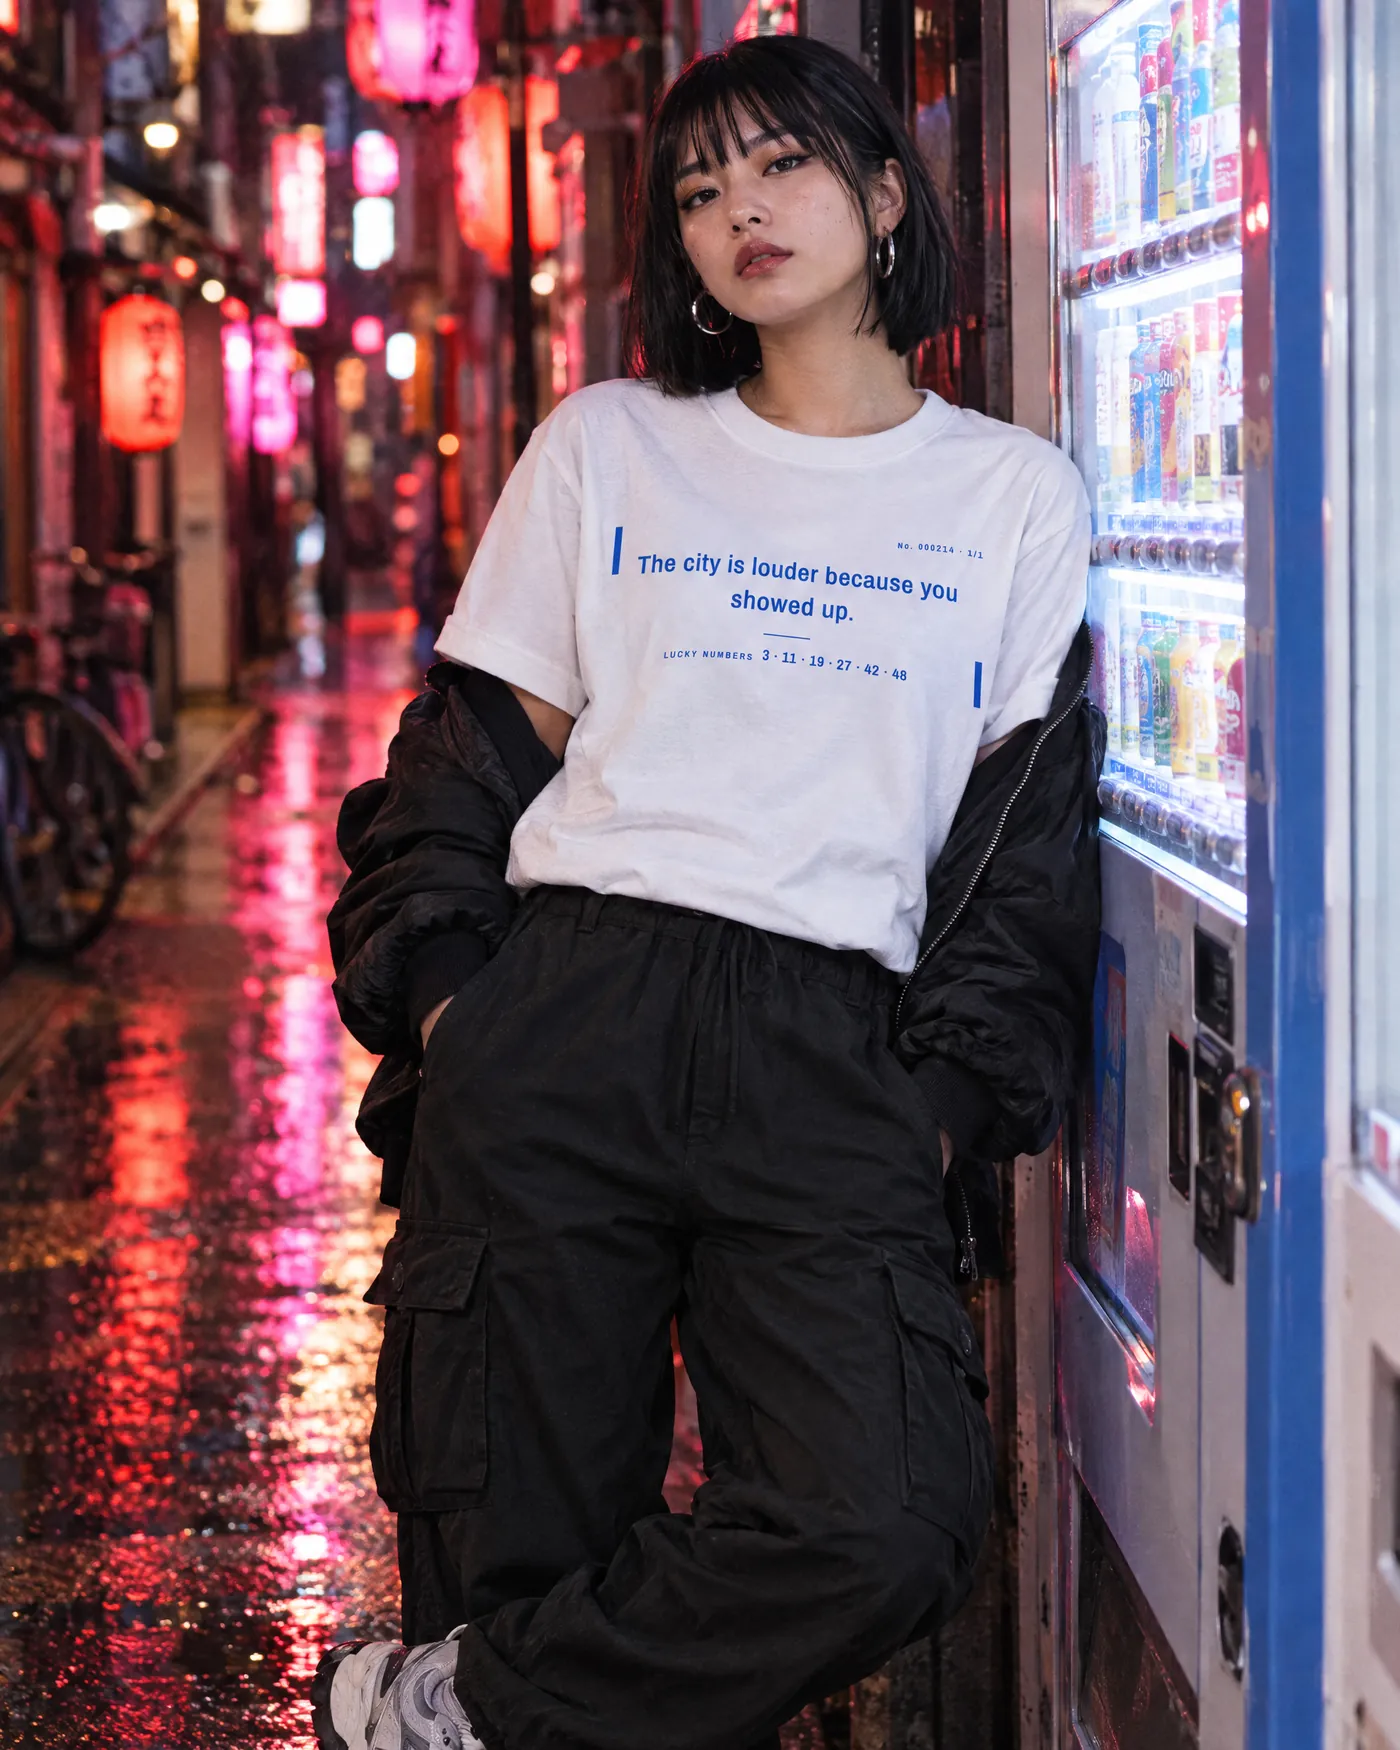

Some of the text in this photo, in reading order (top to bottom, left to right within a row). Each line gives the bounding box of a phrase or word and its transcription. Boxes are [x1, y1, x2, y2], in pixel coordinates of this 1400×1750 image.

[896, 541, 914, 550] No.
[917, 543, 955, 553] 000214
[967, 549, 984, 559] 1/1
[638, 551, 959, 603] The city is louder because you
[730, 588, 855, 625] showed up.
[663, 649, 698, 659] LUCKY
[702, 649, 753, 660] NUMBERS
[761, 648, 771, 661] 3
[781, 651, 797, 664] 11
[809, 655, 826, 668] 19
[835, 658, 853, 672] 27
[863, 663, 880, 677] 42
[891, 666, 908, 681] 48
